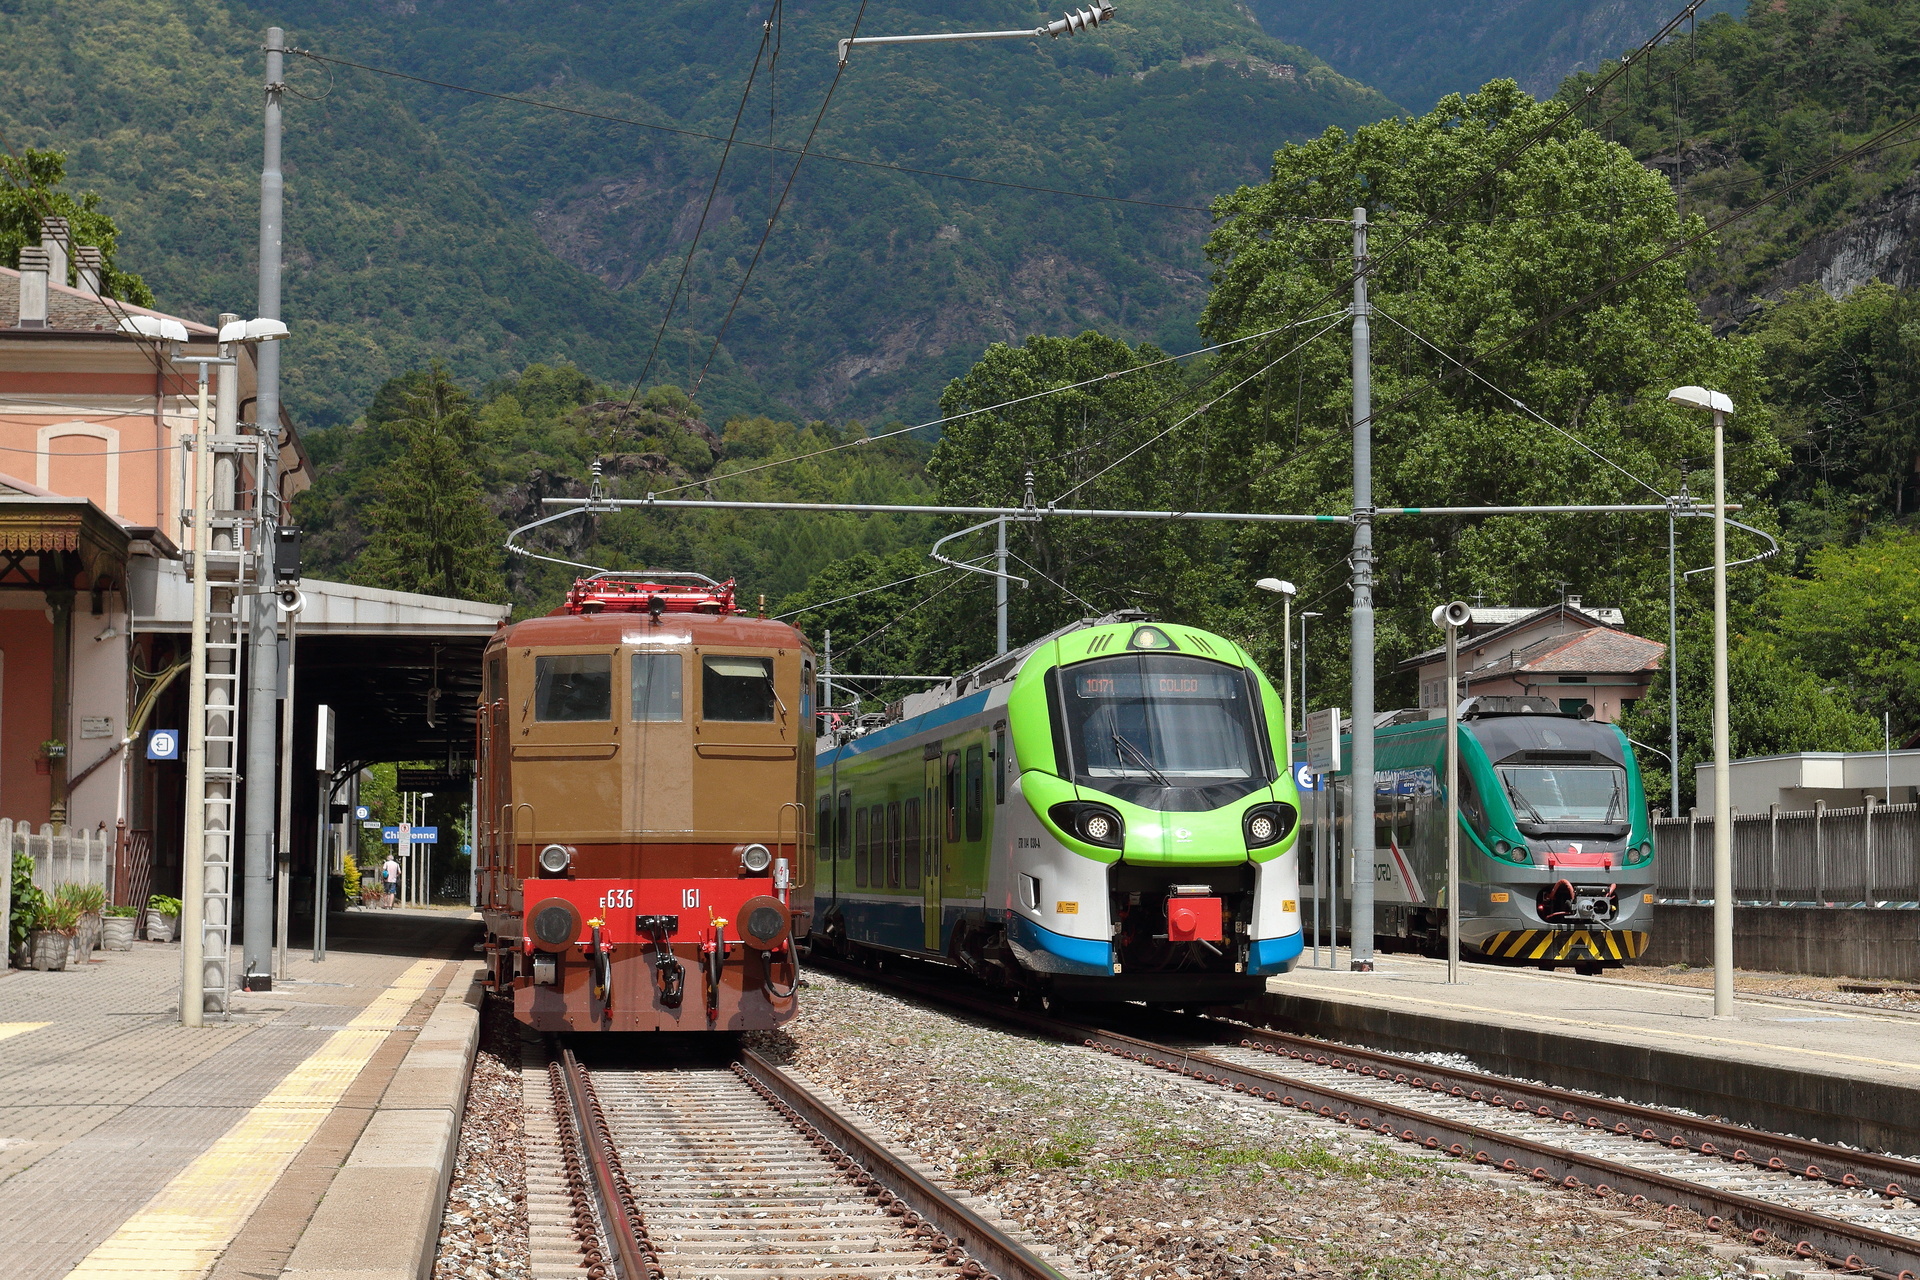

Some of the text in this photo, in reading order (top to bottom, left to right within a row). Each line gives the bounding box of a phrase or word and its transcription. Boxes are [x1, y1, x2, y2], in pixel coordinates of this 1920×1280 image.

[1086, 679, 1198, 692] 10171 COLICO
[384, 831, 435, 839] Chienna
[682, 889, 700, 908] 161
